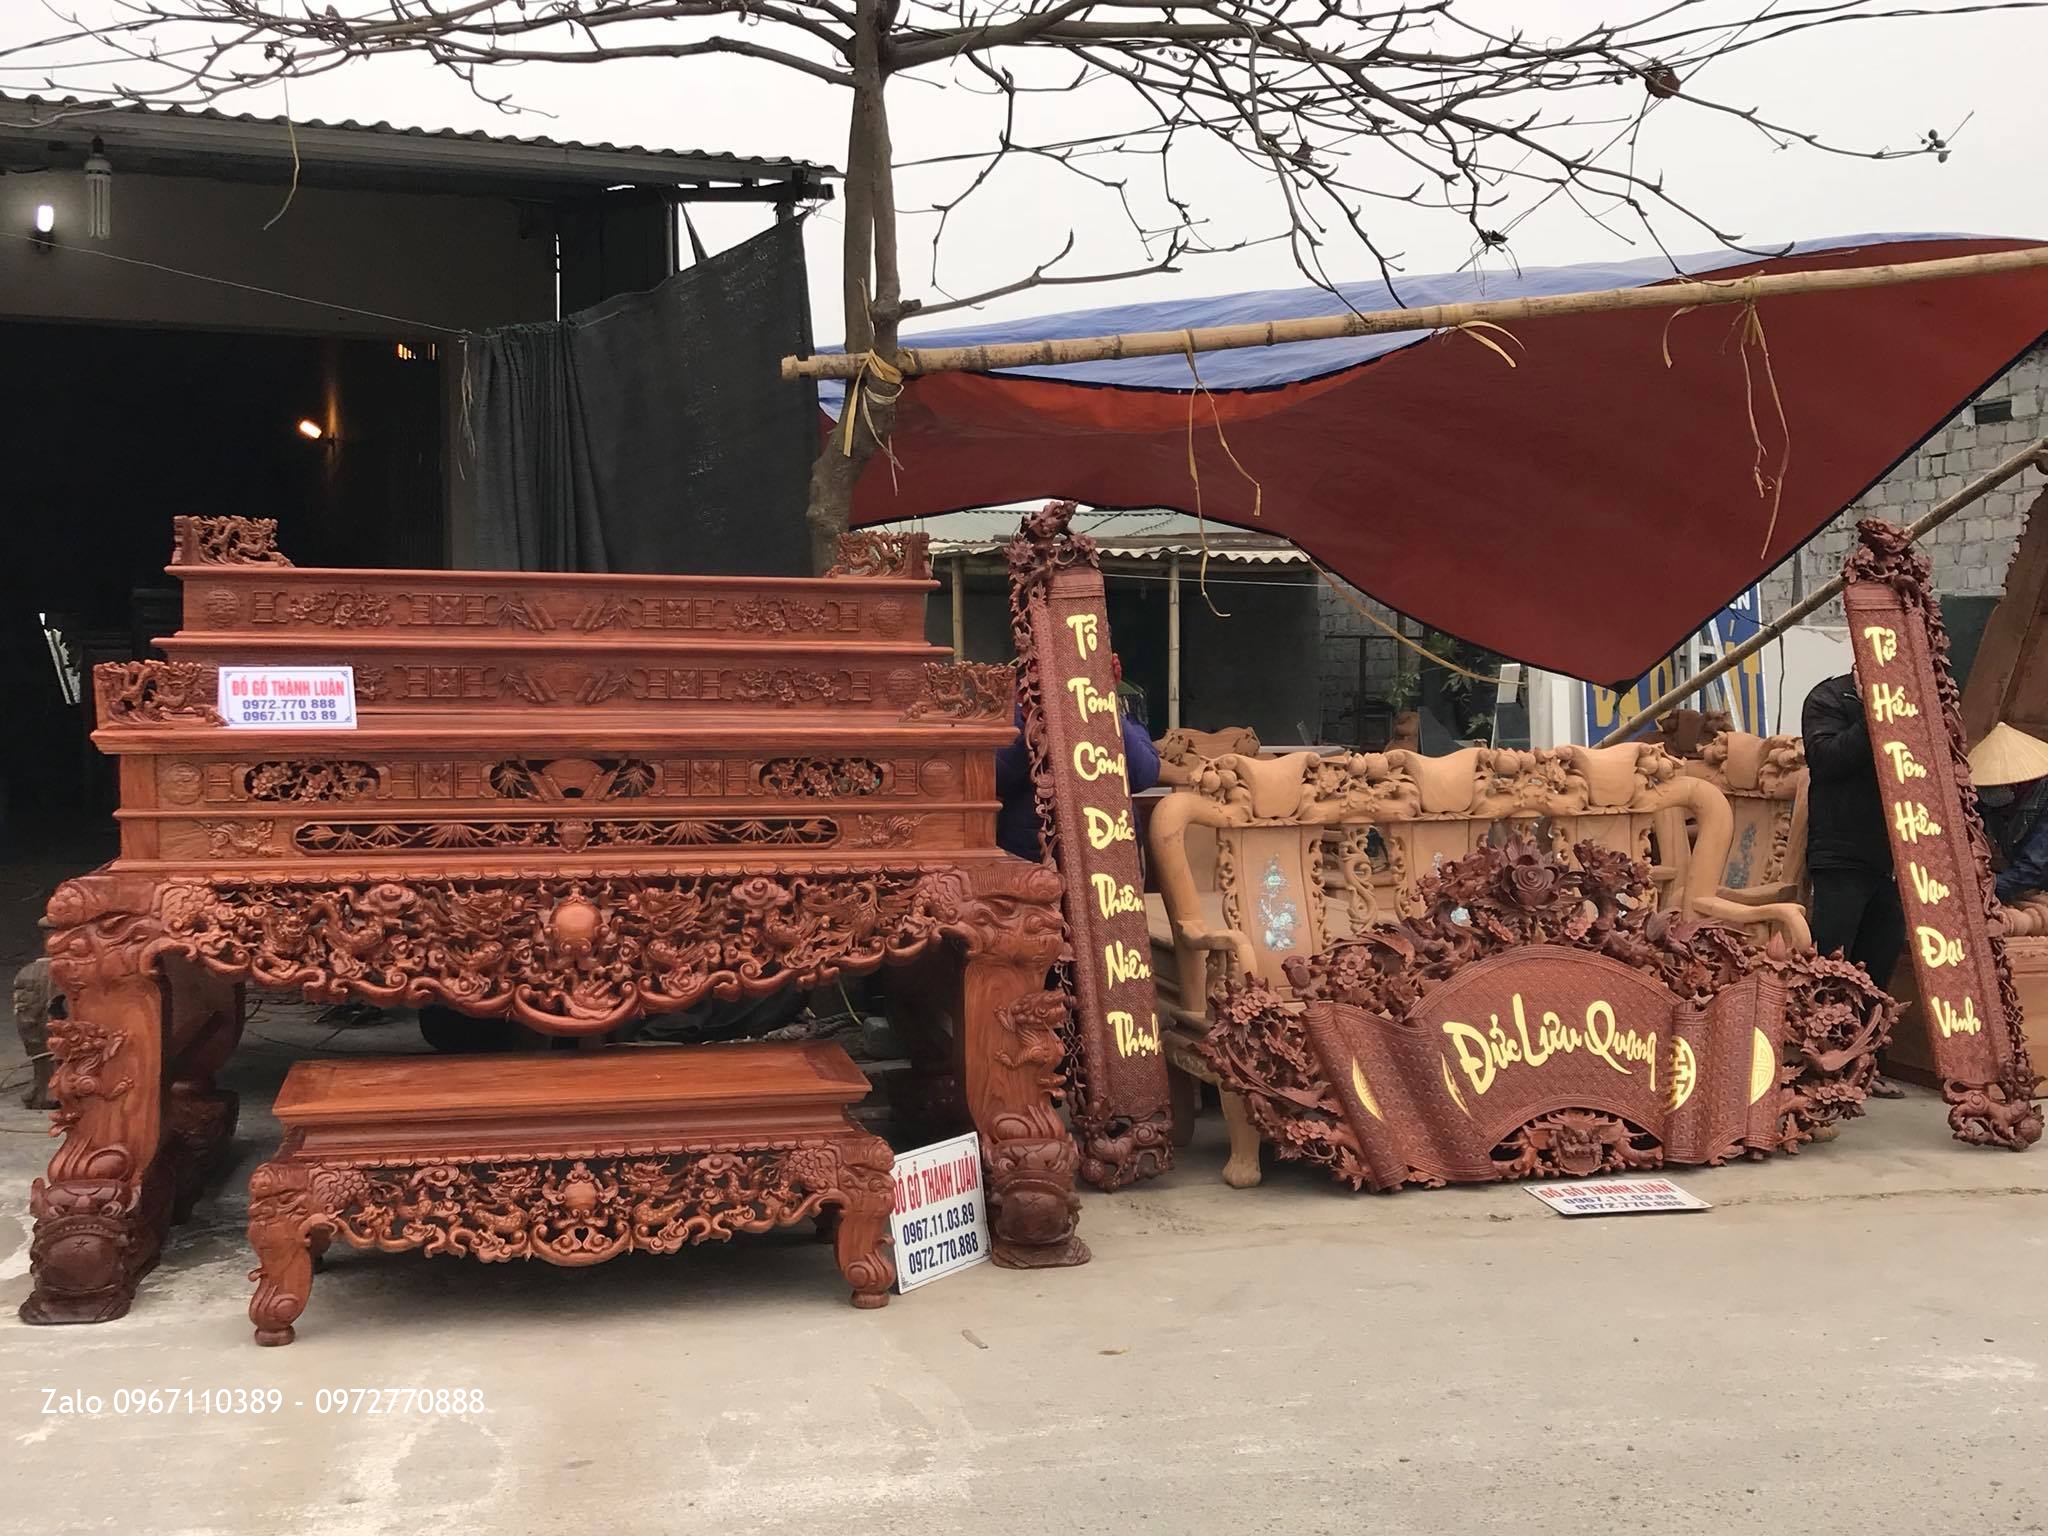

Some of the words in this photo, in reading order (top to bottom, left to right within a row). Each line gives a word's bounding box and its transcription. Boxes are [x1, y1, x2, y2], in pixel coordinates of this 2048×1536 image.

[1066, 613, 1098, 661] Tổ
[242, 699, 306, 710] 0972.770
[311, 699, 336, 709] 888
[272, 677, 311, 697] THÀNH
[314, 677, 345, 697] LUÂN
[1067, 677, 1121, 738] Tông
[243, 711, 296, 721] 0967.11
[1073, 741, 1129, 798] Công
[1883, 741, 1928, 785] Tôn
[1083, 806, 1136, 850] Đức
[1091, 873, 1145, 920] Thiên
[1910, 861, 1951, 905] Vạn
[1105, 940, 1151, 990] Niên
[1916, 925, 1966, 969] Đại
[1931, 996, 1982, 1039] Vinh
[1442, 1013, 1522, 1096] Đức
[1513, 993, 1583, 1067] Lưu
[1585, 1000, 1657, 1092] Quang
[921, 1159, 955, 1206] THÀNH
[955, 1151, 979, 1195] LUÂN
[903, 1202, 975, 1246] 0967.11.03.89
[908, 1231, 979, 1275] 0972.770.888
